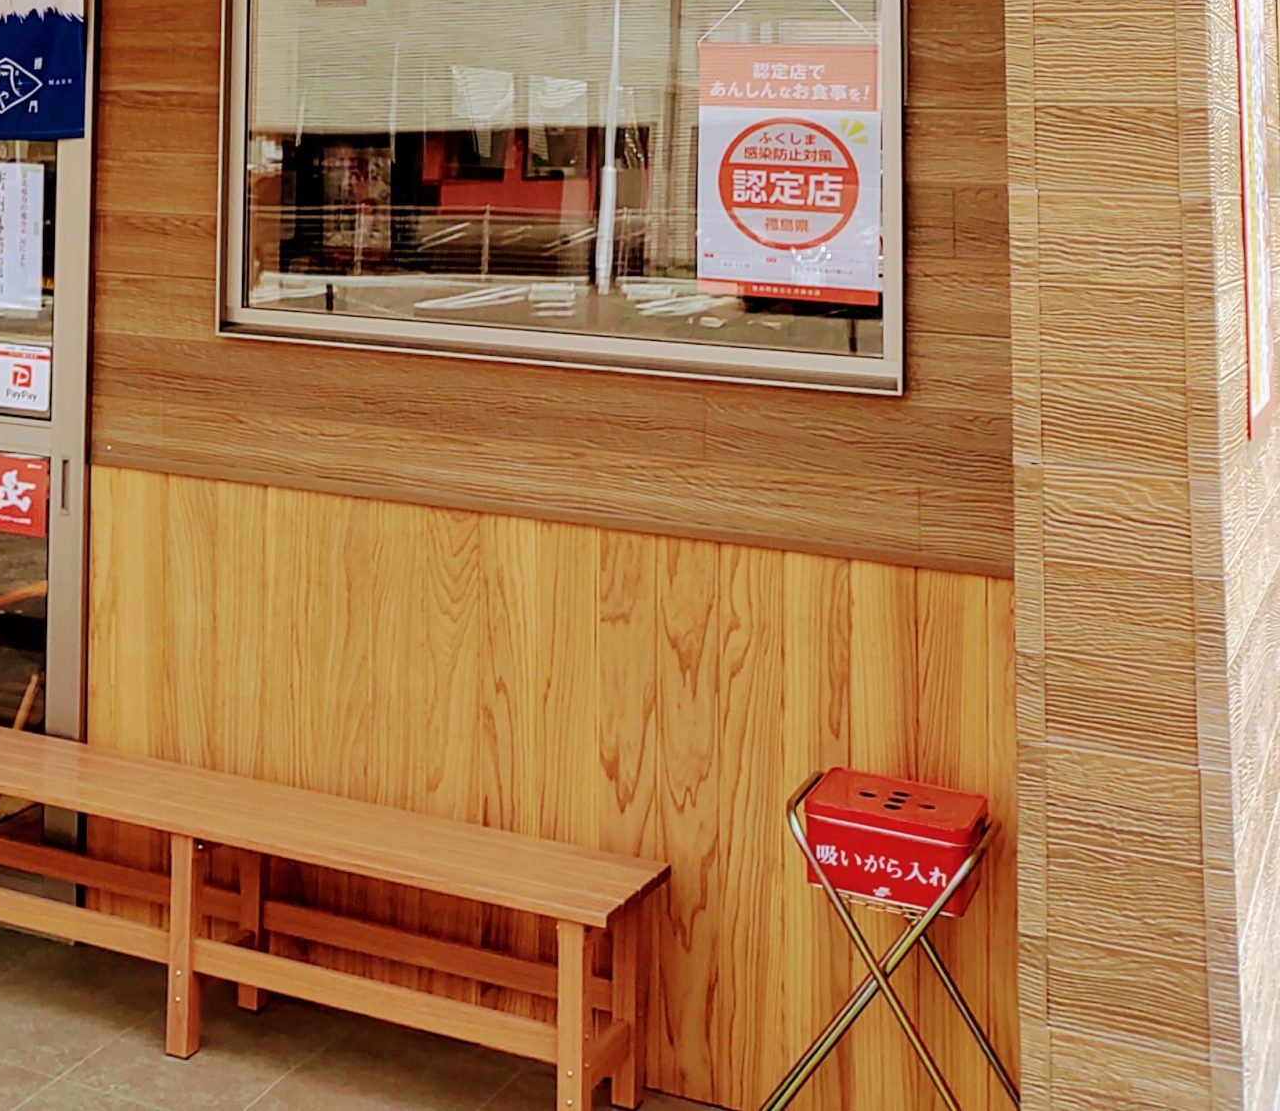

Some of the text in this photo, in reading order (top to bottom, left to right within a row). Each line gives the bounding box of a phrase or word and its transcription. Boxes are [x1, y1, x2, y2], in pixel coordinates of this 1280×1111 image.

[752, 62, 826, 80] 認定店で
[709, 81, 870, 102] あんしんなお食事を!
[759, 131, 817, 145] ふくしま
[744, 147, 833, 163] 感染防止対策
[732, 169, 844, 208] 認定店
[764, 217, 809, 233] 福島県
[5, 388, 38, 402] PayPay
